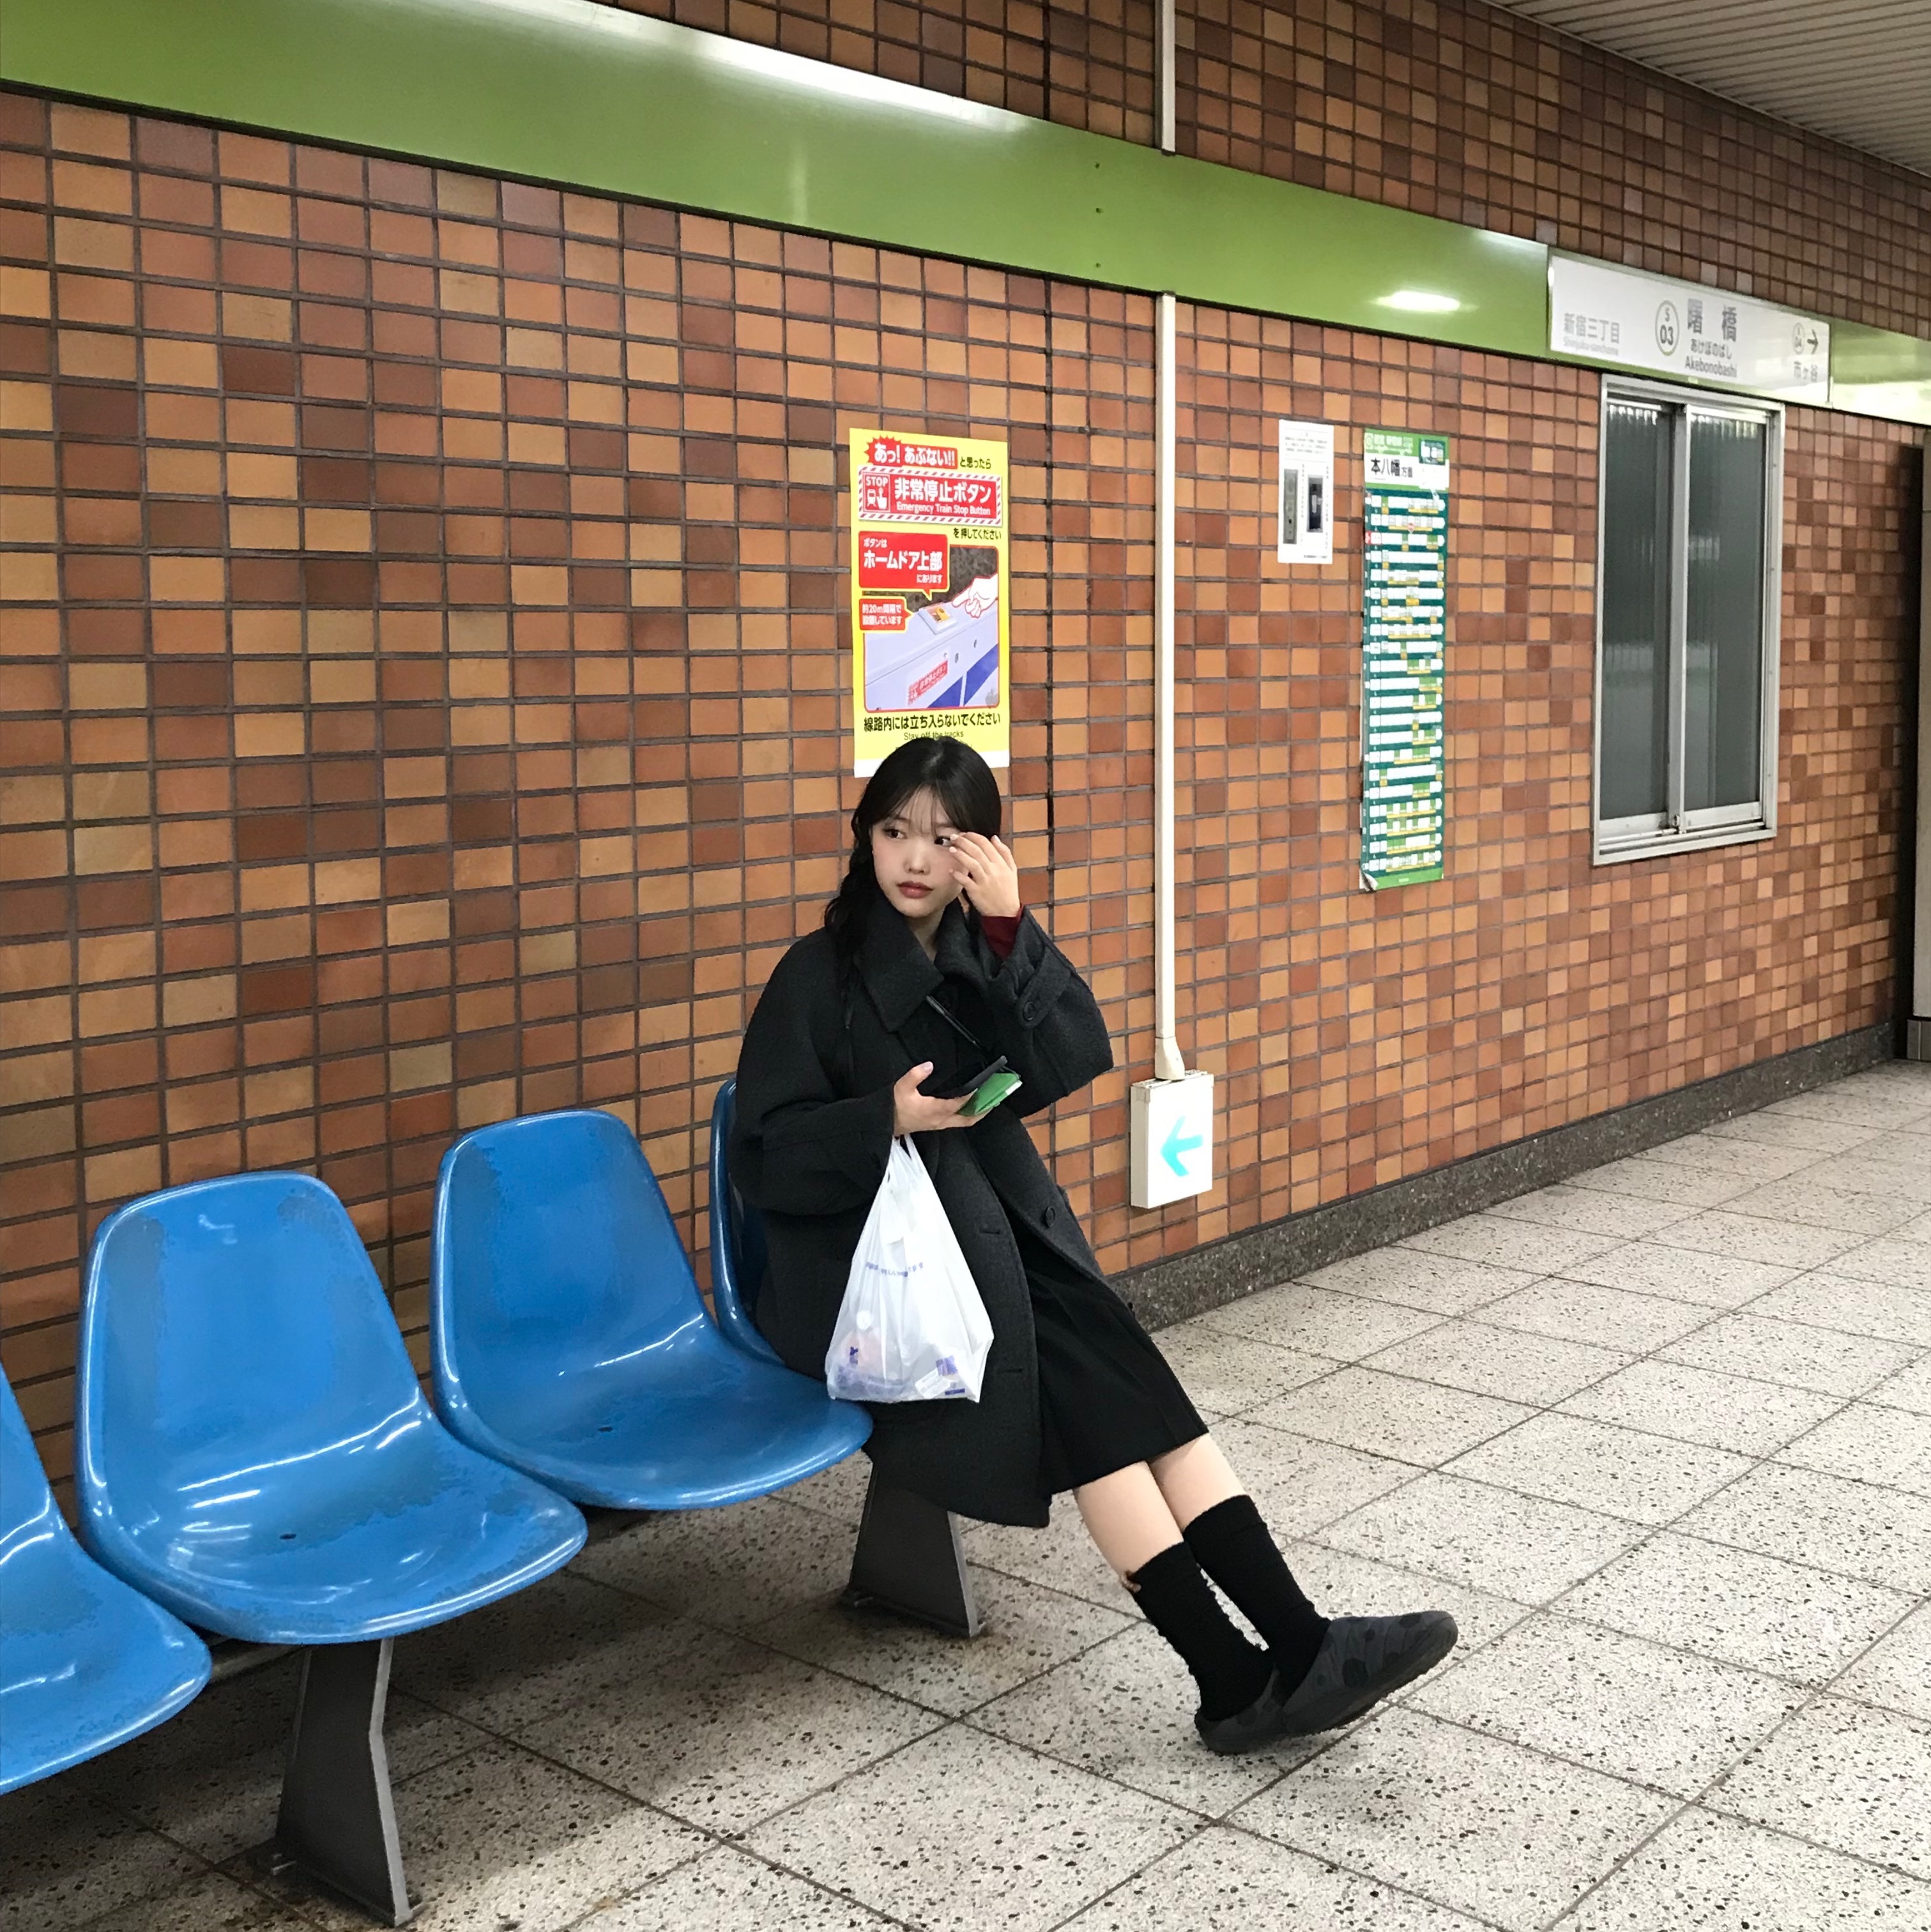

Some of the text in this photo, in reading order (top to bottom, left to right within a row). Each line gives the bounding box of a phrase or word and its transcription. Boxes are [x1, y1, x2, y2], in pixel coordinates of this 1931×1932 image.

[1563, 312, 1619, 344] 新宿三丁目
[1660, 324, 1674, 345] 03
[1685, 355, 1737, 378] Akebonobashi
[959, 457, 991, 469] と思ったら
[866, 476, 889, 487] STOP
[894, 477, 991, 504] 非常停止ボタン
[896, 503, 991, 515] Emergency Train Stop Button
[953, 528, 1002, 540] を押してください
[864, 537, 888, 548] ボタンは
[864, 550, 943, 571] ホームドア上部
[916, 574, 943, 584] にあります
[864, 713, 1001, 732] 線路内には立ち入らないでください
[904, 732, 919, 740] Stay
